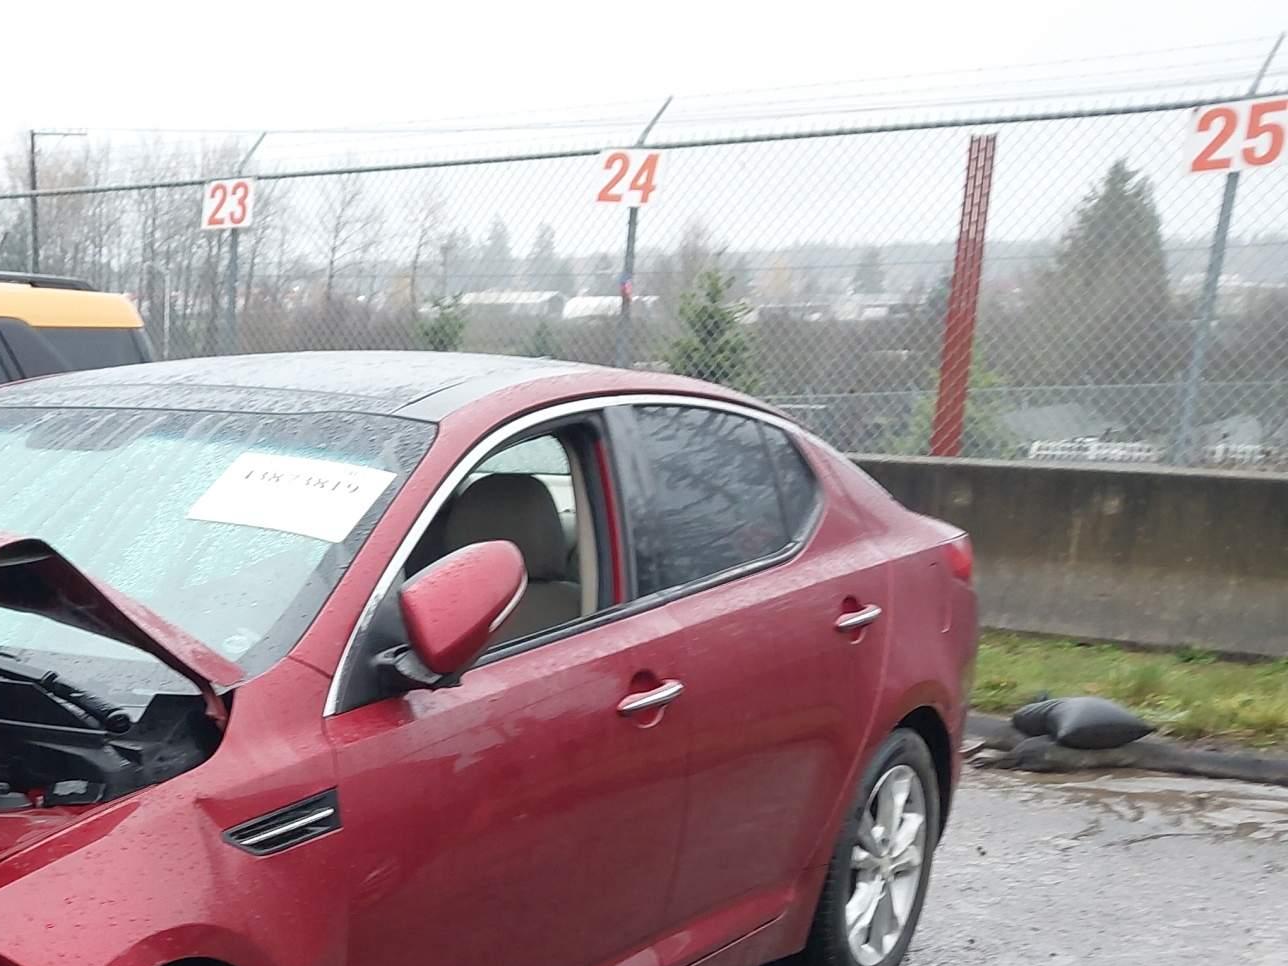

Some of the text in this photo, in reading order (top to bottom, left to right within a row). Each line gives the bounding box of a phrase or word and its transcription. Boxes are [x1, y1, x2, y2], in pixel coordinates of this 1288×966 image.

[1191, 99, 1288, 173] 25
[596, 151, 661, 205] 24
[206, 180, 250, 227] 23
[243, 469, 360, 494] 383819
